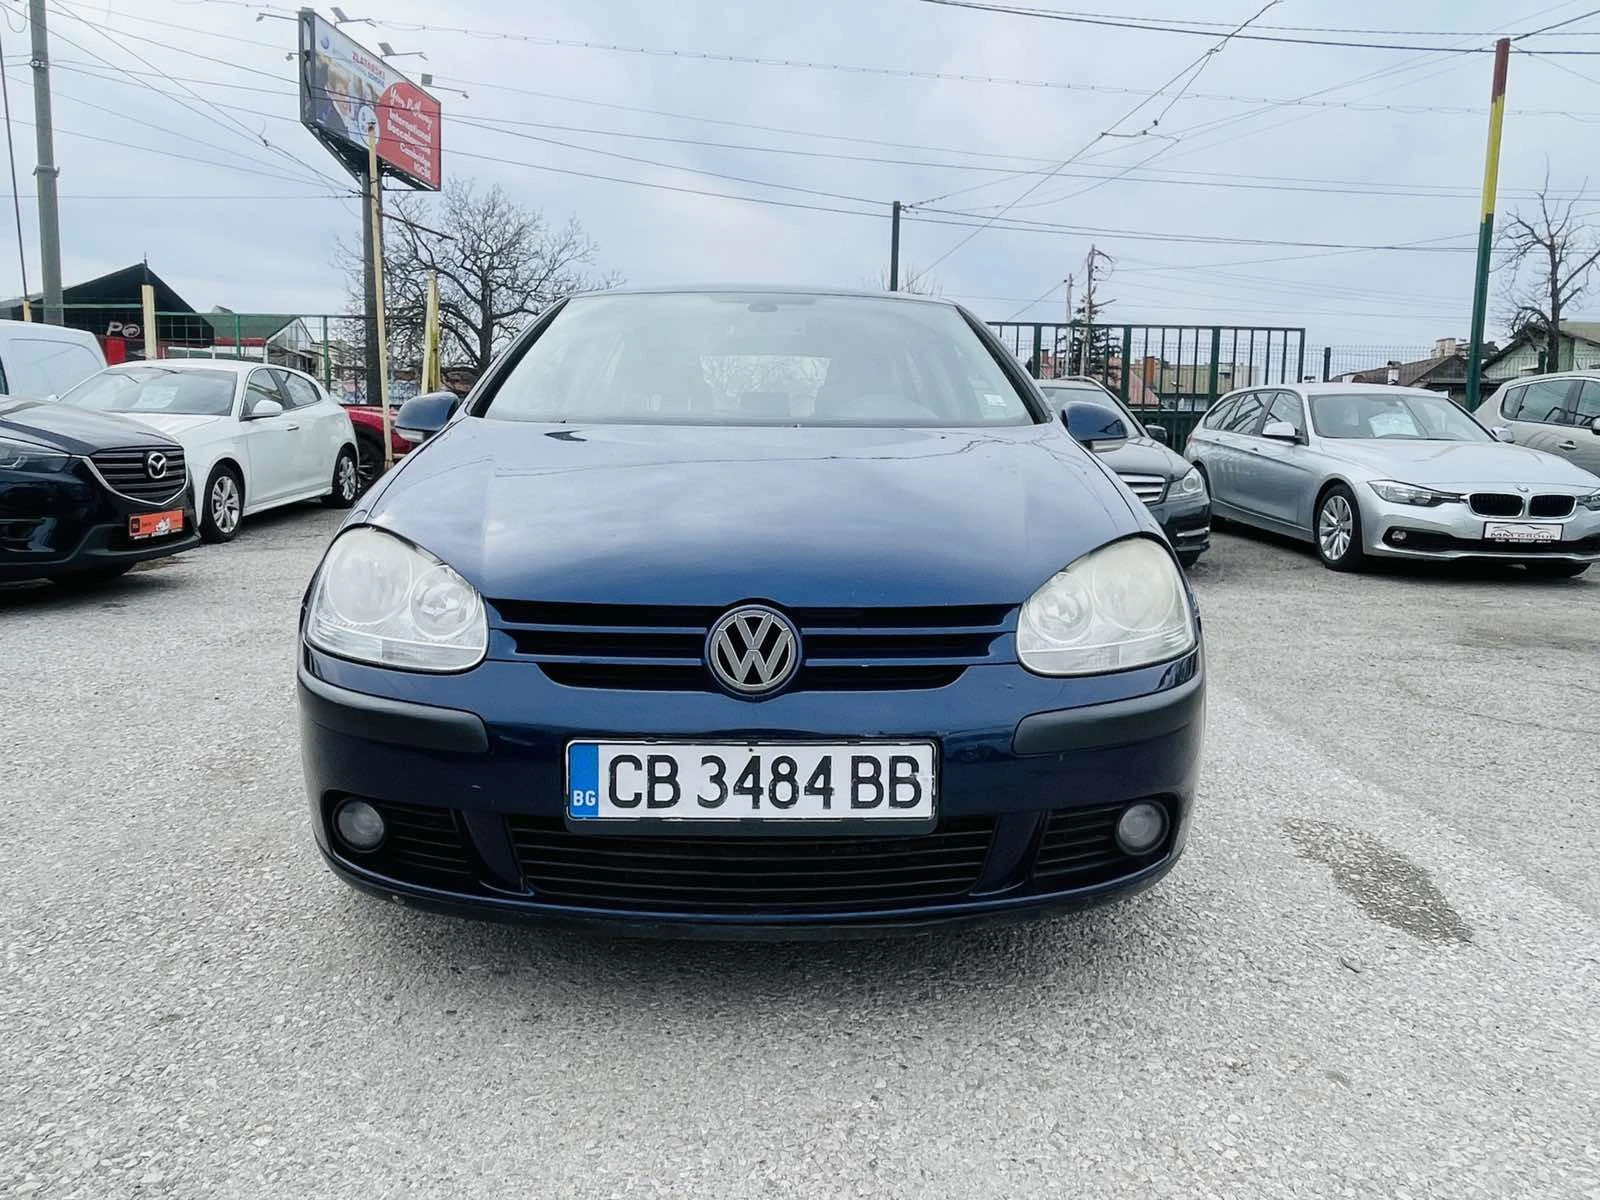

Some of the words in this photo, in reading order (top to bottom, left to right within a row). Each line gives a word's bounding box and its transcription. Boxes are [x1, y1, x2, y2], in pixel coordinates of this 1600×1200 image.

[572, 790, 596, 806] BG
[608, 754, 682, 809] CB
[697, 754, 834, 810] 3484
[850, 754, 922, 810] BB
